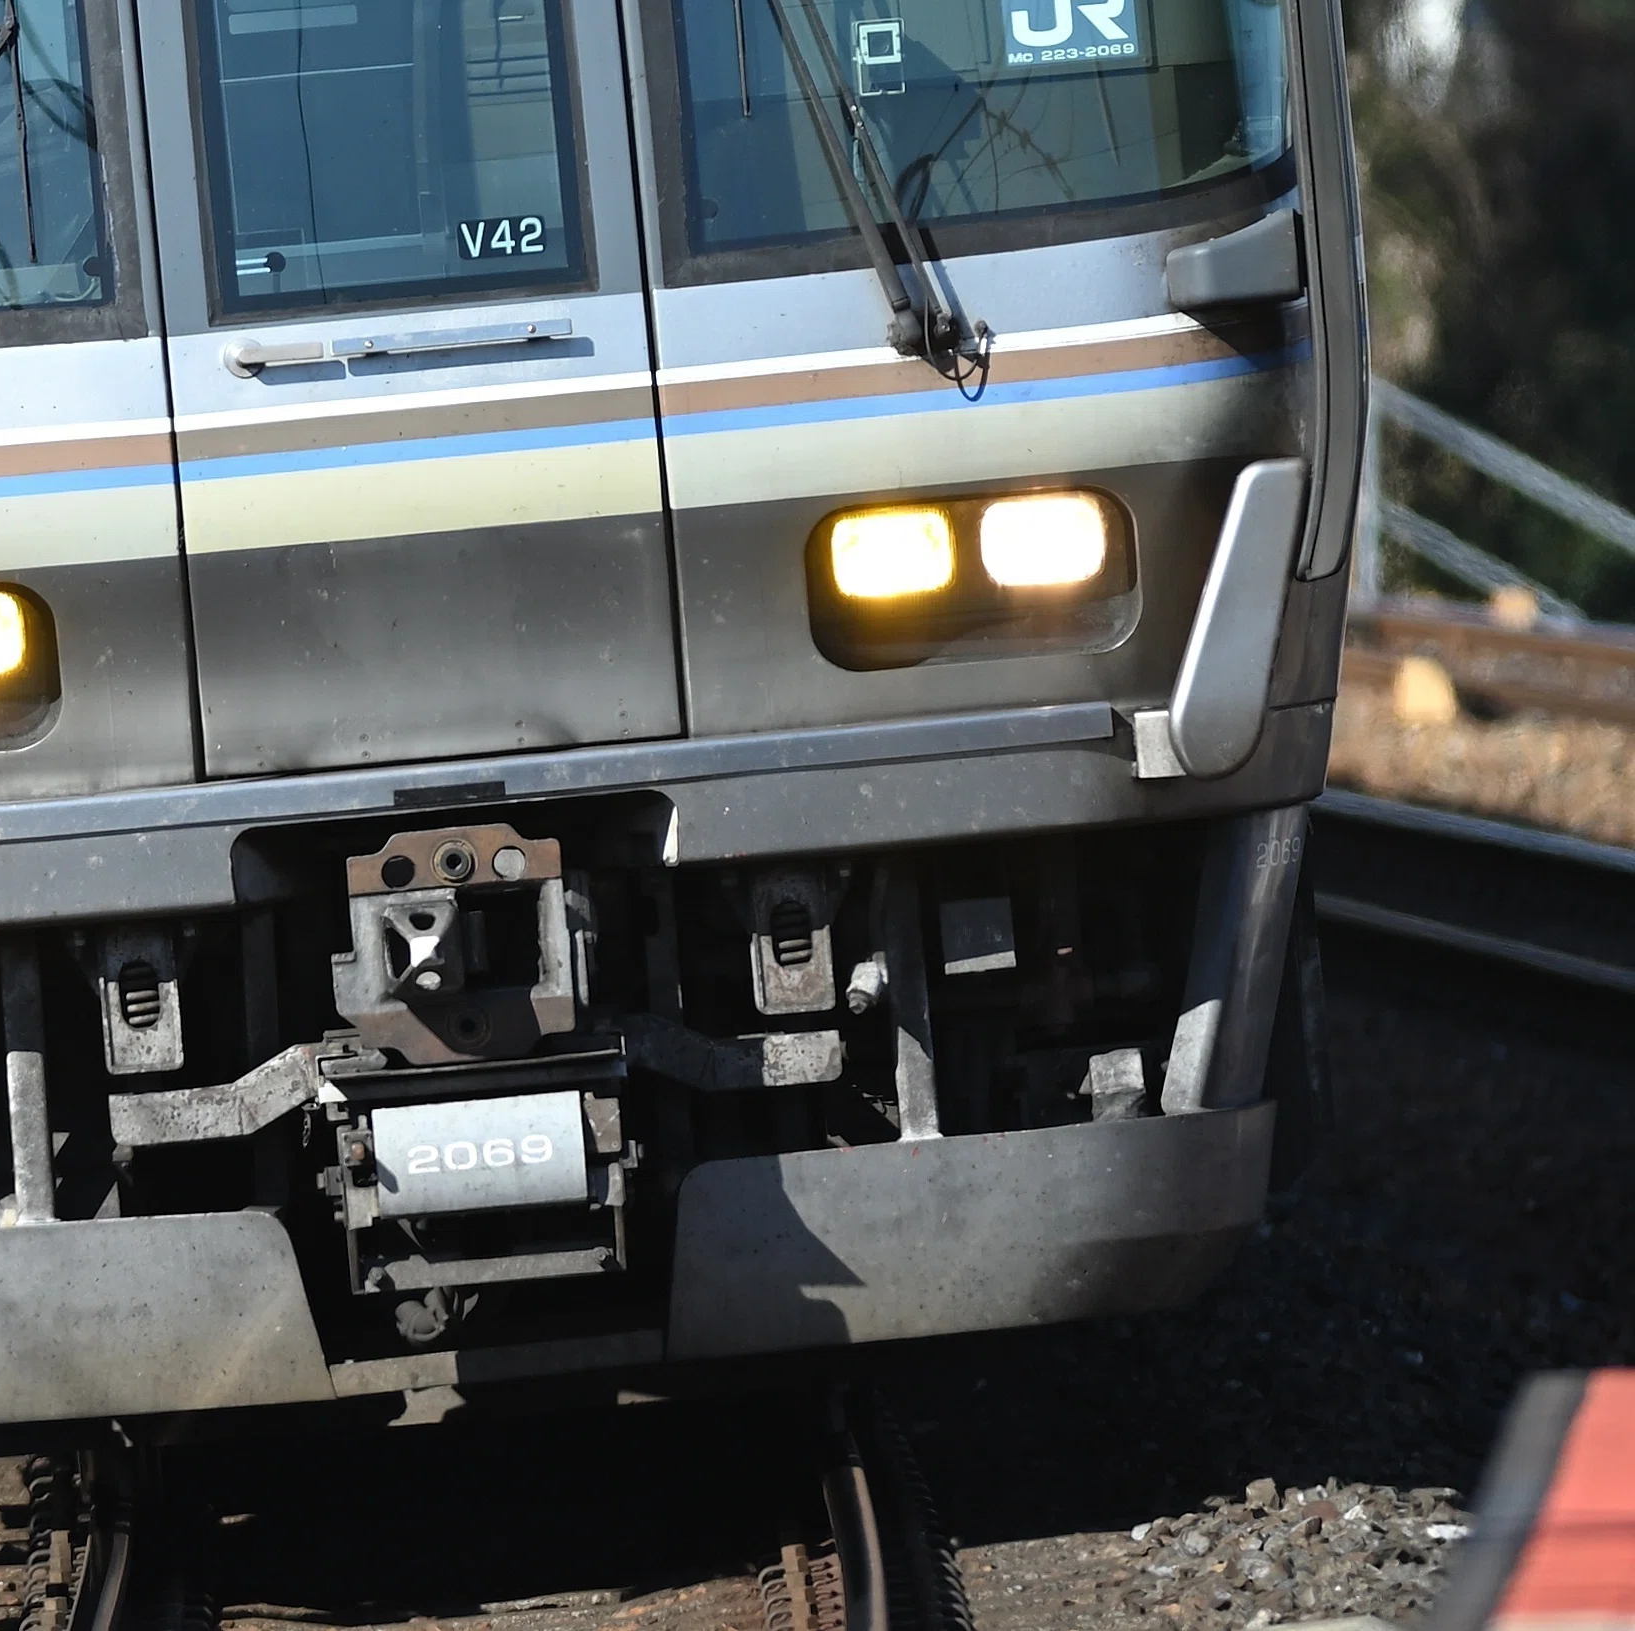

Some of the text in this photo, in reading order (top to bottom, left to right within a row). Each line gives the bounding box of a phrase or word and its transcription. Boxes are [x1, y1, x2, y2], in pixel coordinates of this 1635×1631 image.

[1040, 42, 1135, 61] 223-2069
[460, 216, 544, 259] V42
[1256, 836, 1301, 868] 2069
[406, 1133, 554, 1175] 2069
